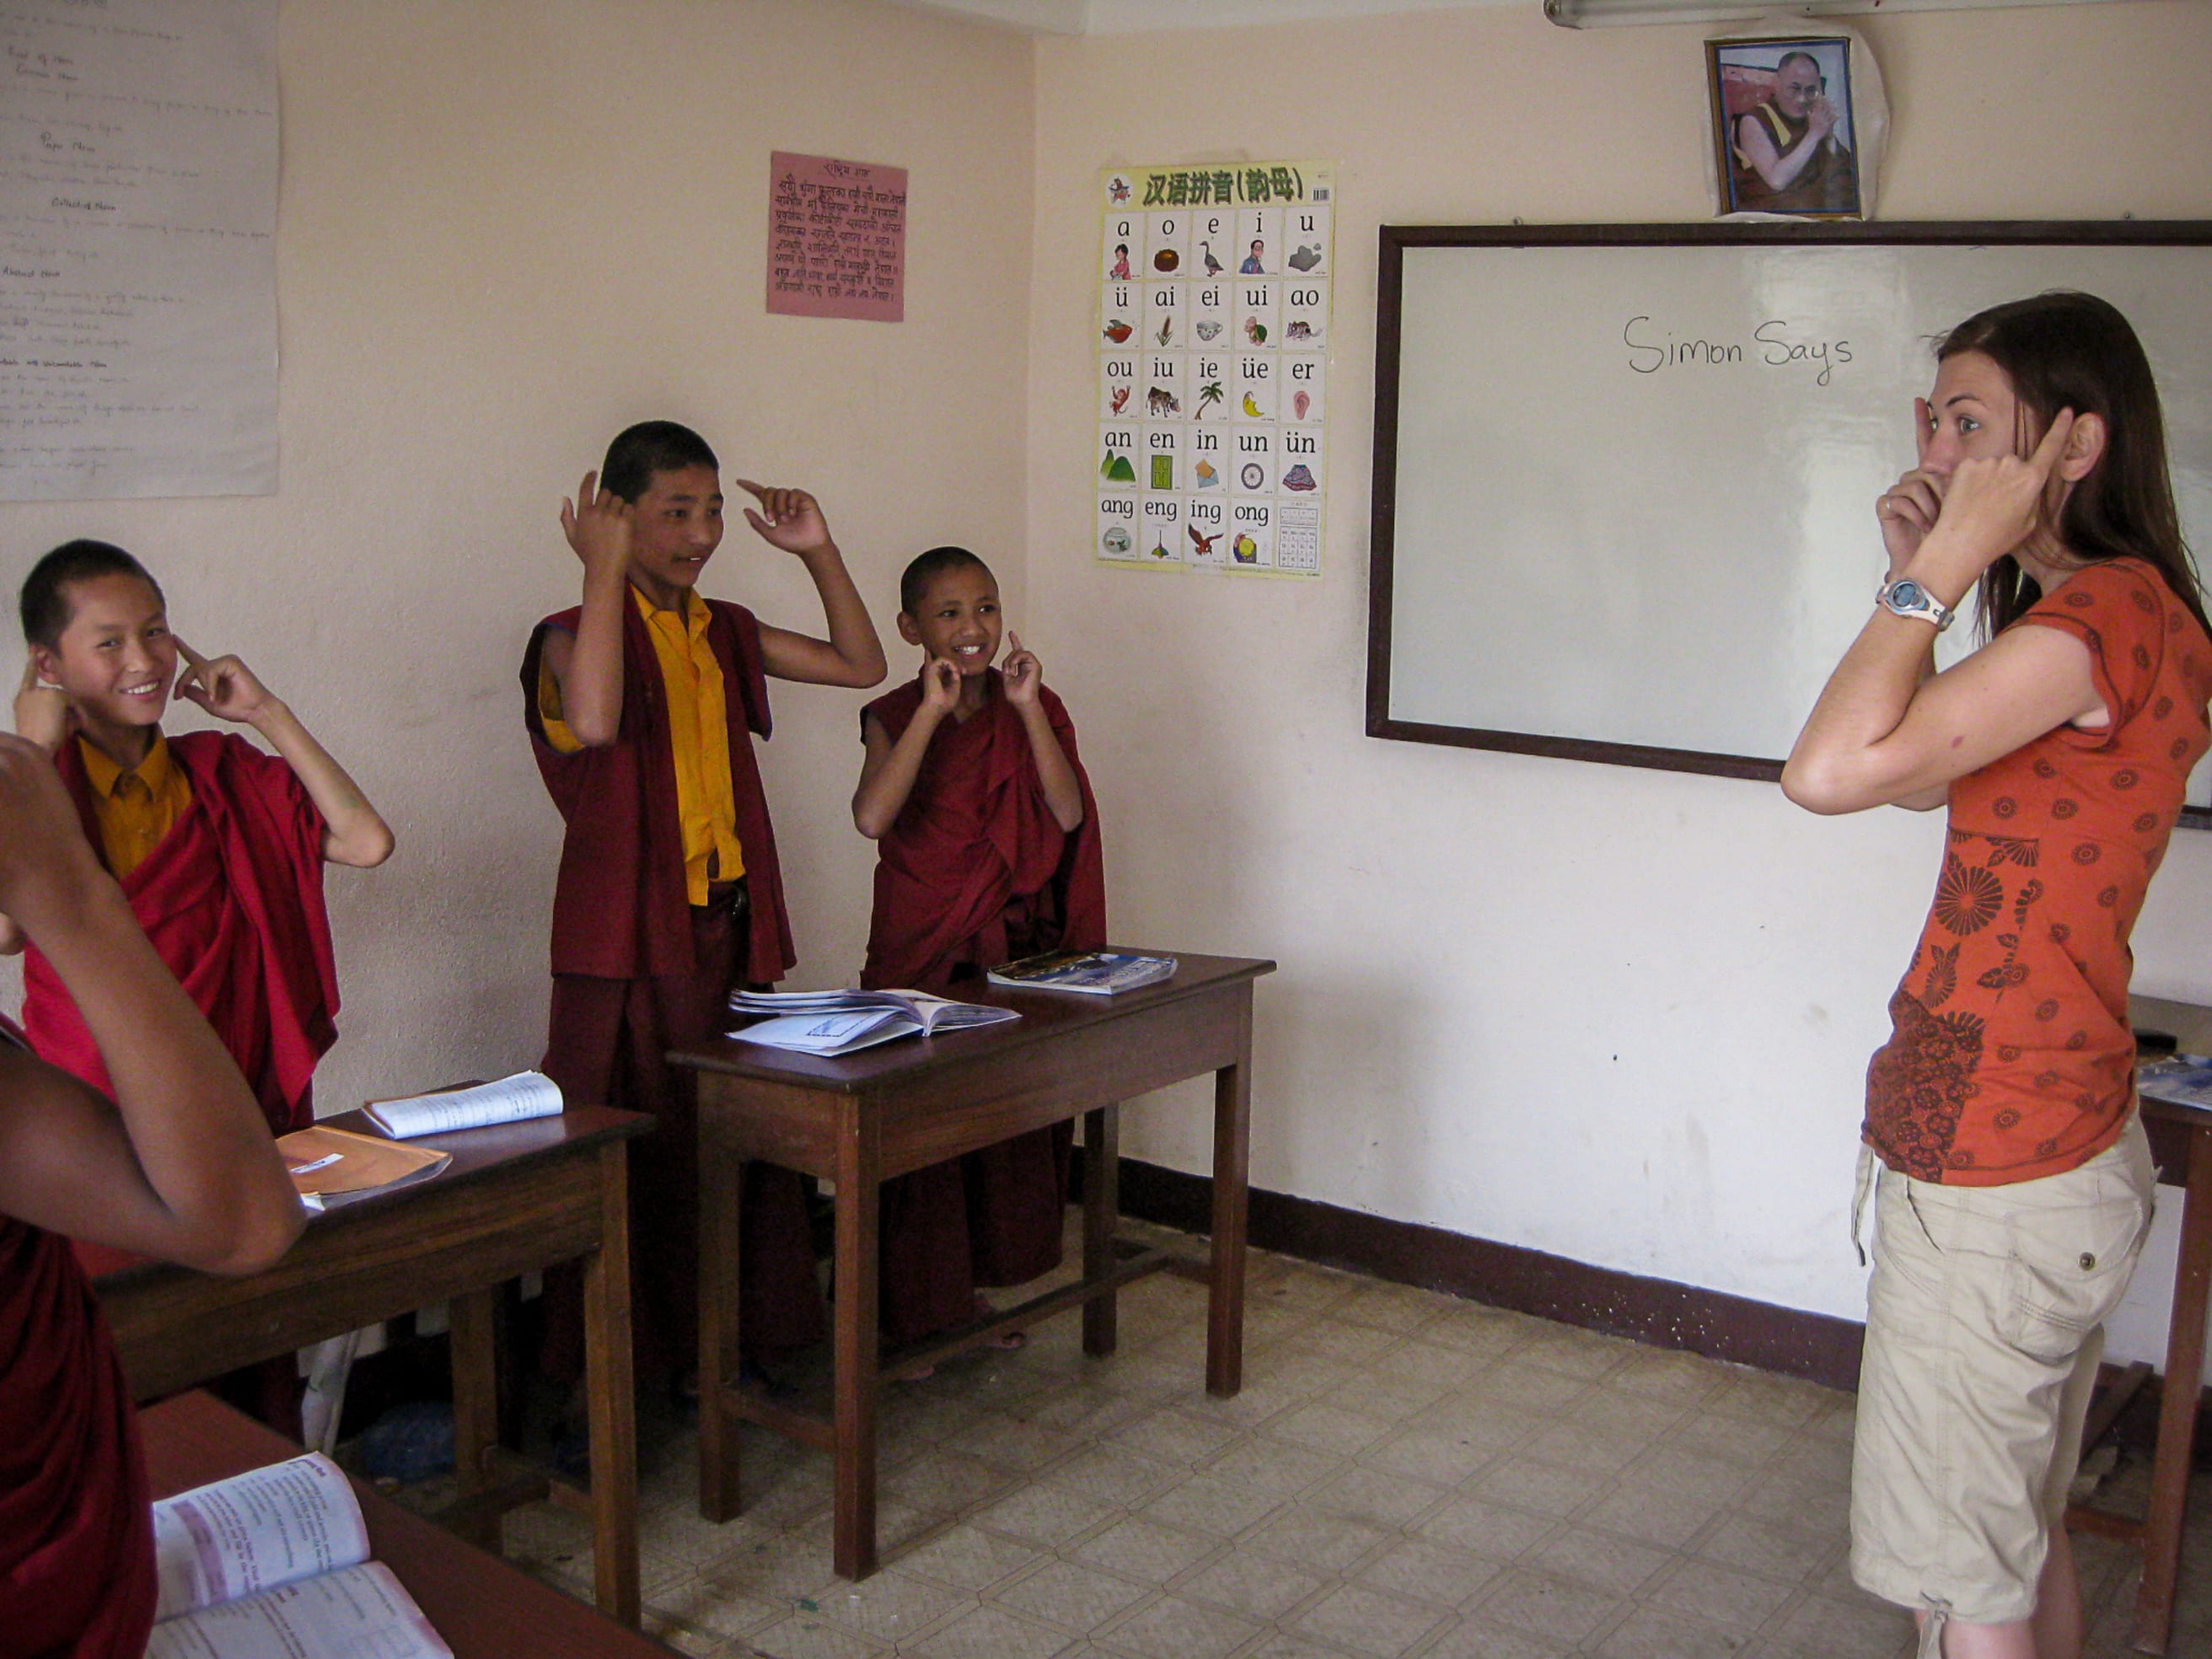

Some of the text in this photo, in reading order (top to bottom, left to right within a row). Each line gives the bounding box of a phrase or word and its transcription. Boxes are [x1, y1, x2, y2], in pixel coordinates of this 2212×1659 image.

[1117, 212, 1314, 237] a o e i u
[1115, 284, 1319, 308] ü ai ei ui ao
[1624, 316, 1853, 386] Simon Says
[1107, 357, 1315, 380] ou iu ie üe er
[1104, 429, 1316, 454] an en in un ün
[1101, 499, 1269, 527] ang eng ing ong
